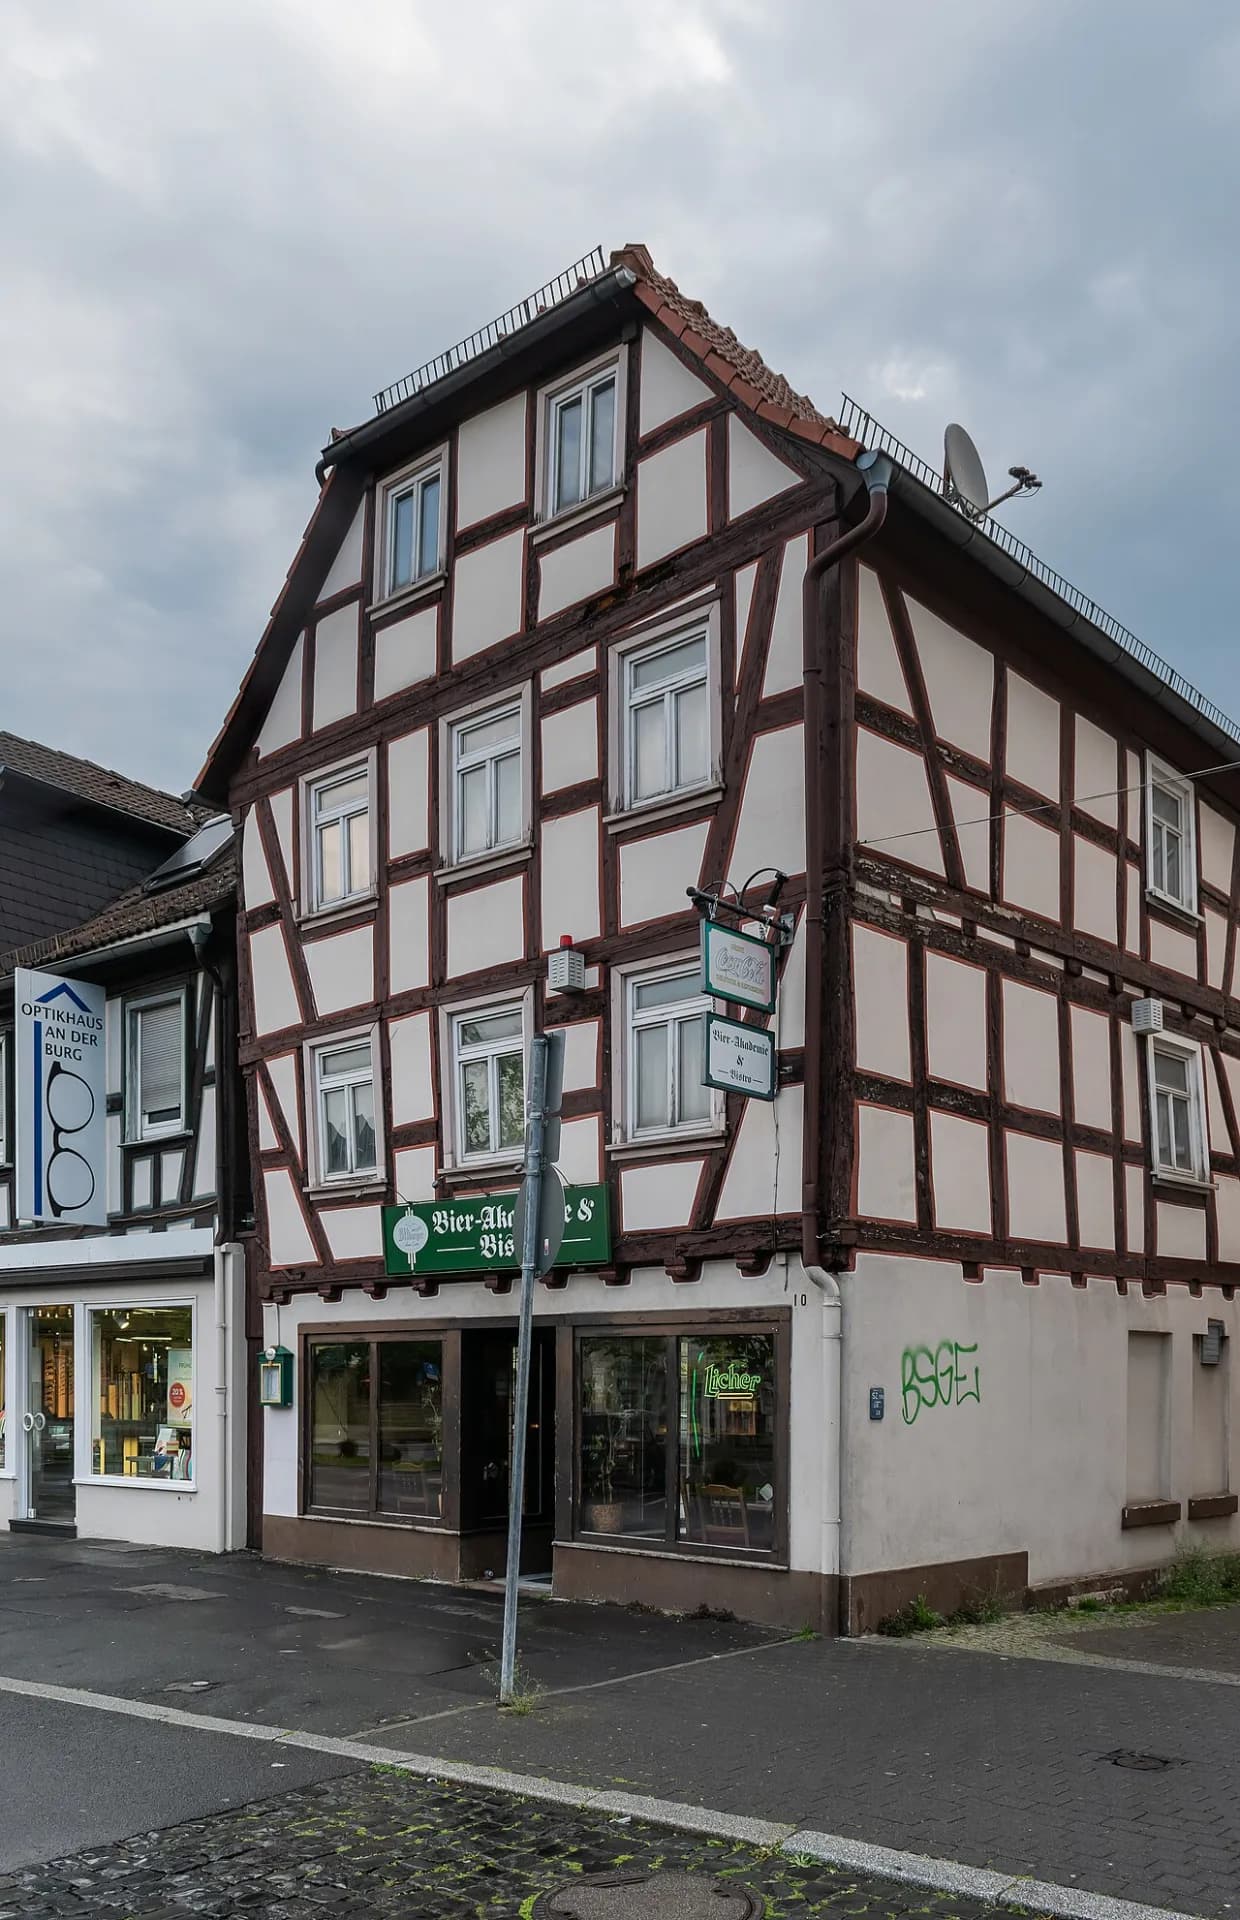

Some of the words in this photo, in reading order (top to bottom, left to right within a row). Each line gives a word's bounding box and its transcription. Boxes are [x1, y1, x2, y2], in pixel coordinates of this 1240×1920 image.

[21, 1002, 104, 1031] OPTIKHAUS
[45, 1026, 66, 1041] AN
[71, 1030, 98, 1047] DER
[45, 1043, 82, 1062] BURG
[736, 1054, 745, 1067] &
[730, 1068, 752, 1084] Bistro
[576, 1197, 595, 1223] &
[793, 1293, 807, 1307] 10
[703, 1363, 762, 1398] Licher
